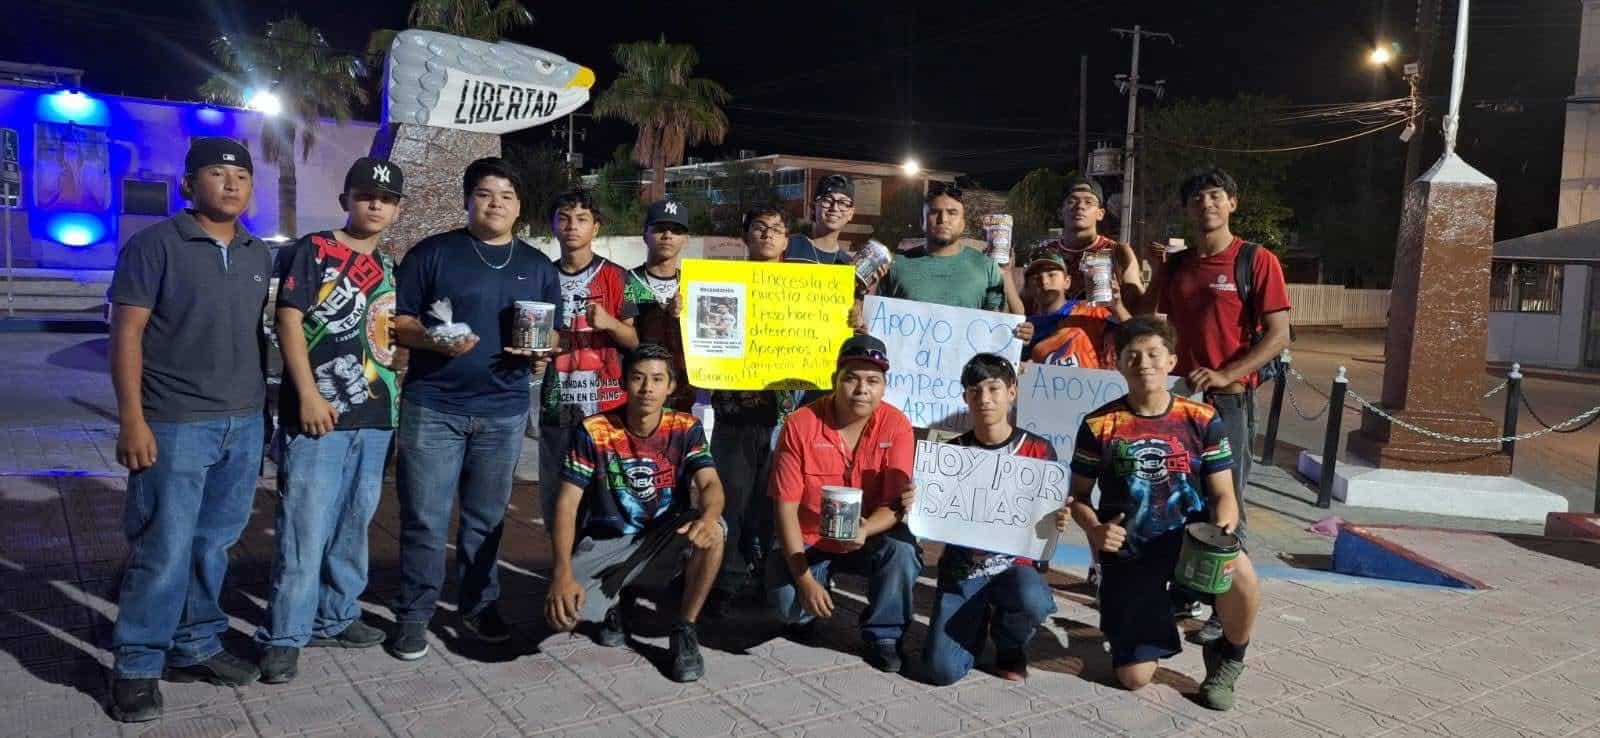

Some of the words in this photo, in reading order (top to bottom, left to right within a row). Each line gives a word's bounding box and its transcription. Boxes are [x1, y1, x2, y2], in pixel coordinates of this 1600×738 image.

[453, 79, 558, 125] LIBERTAD
[372, 164, 391, 183] NY
[915, 347, 943, 371] al
[915, 441, 986, 482] HOY
[991, 452, 1066, 501] POR
